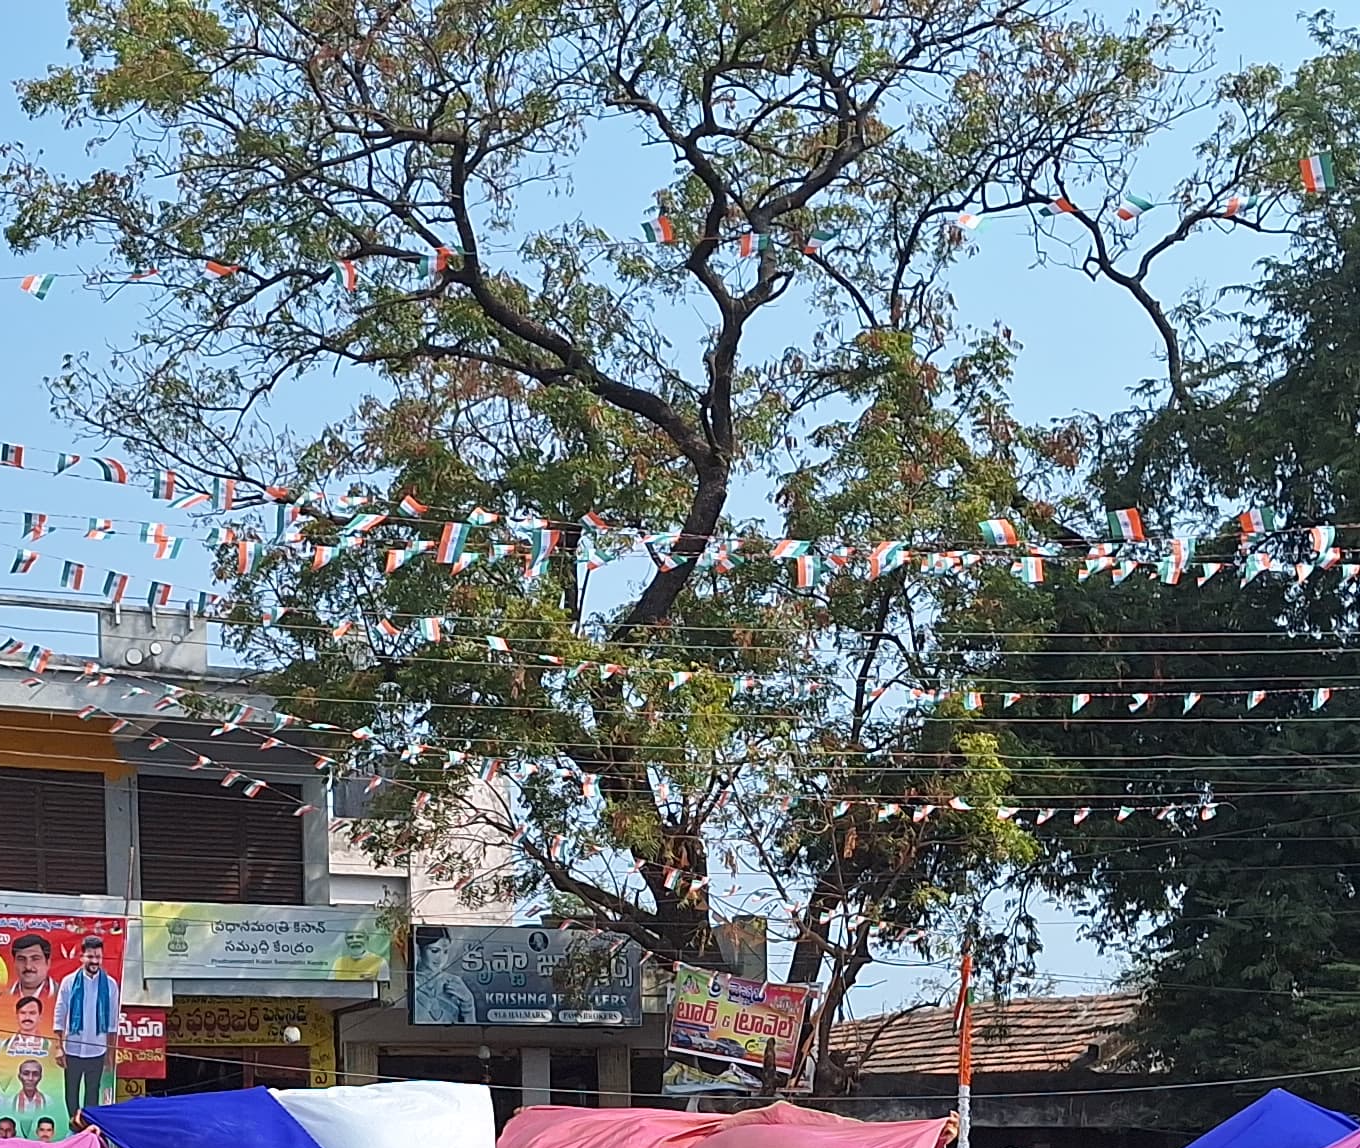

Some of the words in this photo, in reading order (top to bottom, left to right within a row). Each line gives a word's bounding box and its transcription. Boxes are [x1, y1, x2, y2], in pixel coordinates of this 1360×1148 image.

[211, 919, 290, 935] ప్రధానమంత్రి
[293, 920, 327, 934] కిసాన్
[273, 940, 314, 955] కేంద్రం
[485, 992, 547, 1005] KRISHNA
